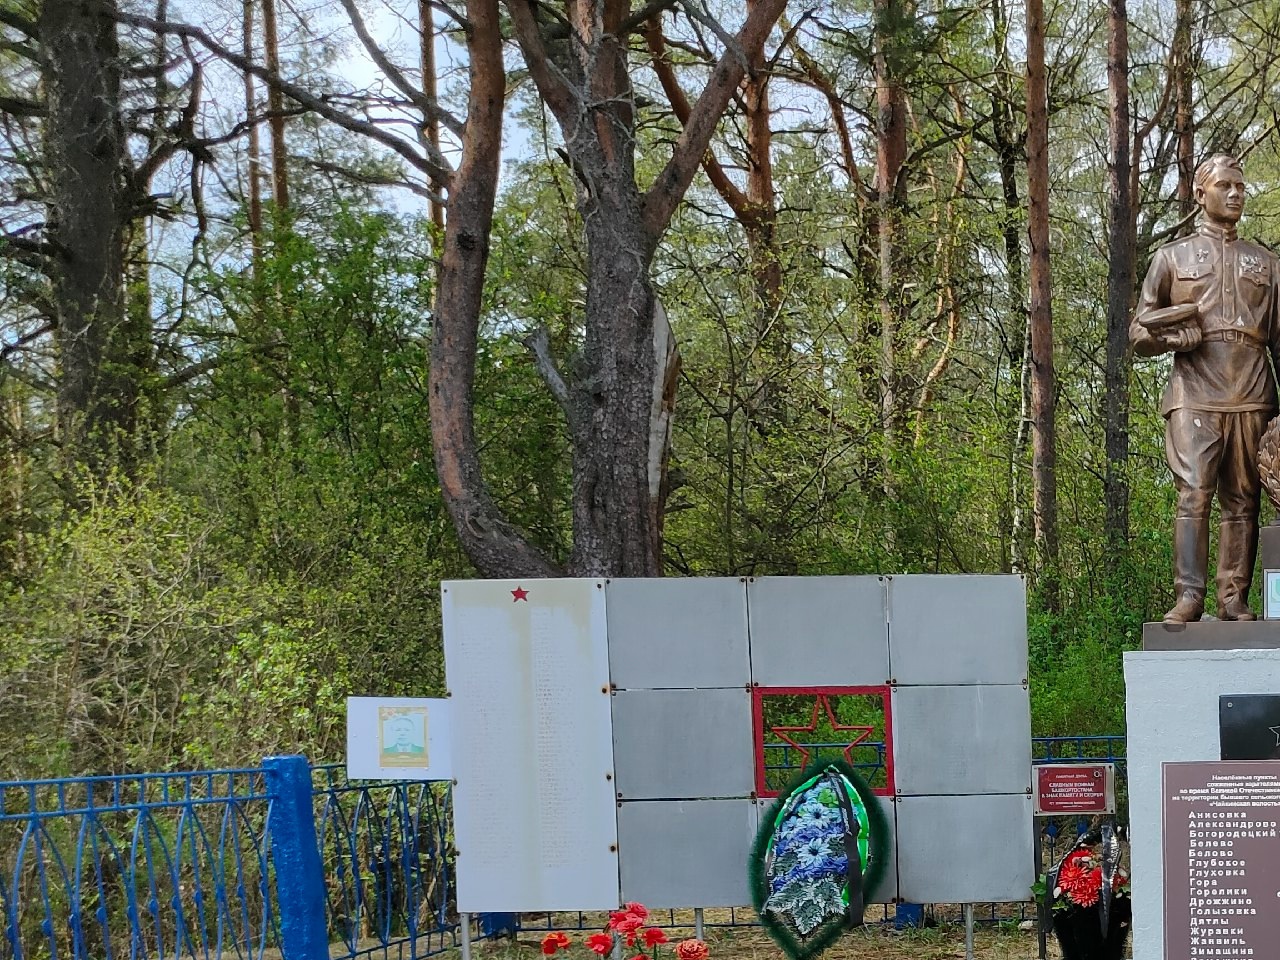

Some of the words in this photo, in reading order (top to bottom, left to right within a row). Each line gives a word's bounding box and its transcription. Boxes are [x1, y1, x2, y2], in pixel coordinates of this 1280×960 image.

[1189, 821, 1276, 829] Александрово
[1190, 829, 1276, 839] Богородецкий
[1189, 859, 1245, 868] Глубокое
[1189, 869, 1245, 878] Глуховка
[1190, 878, 1217, 887] Гора
[1189, 898, 1252, 907] Дрожжино
[1190, 918, 1228, 926] Дятлы
[1191, 927, 1243, 937] Журавки
